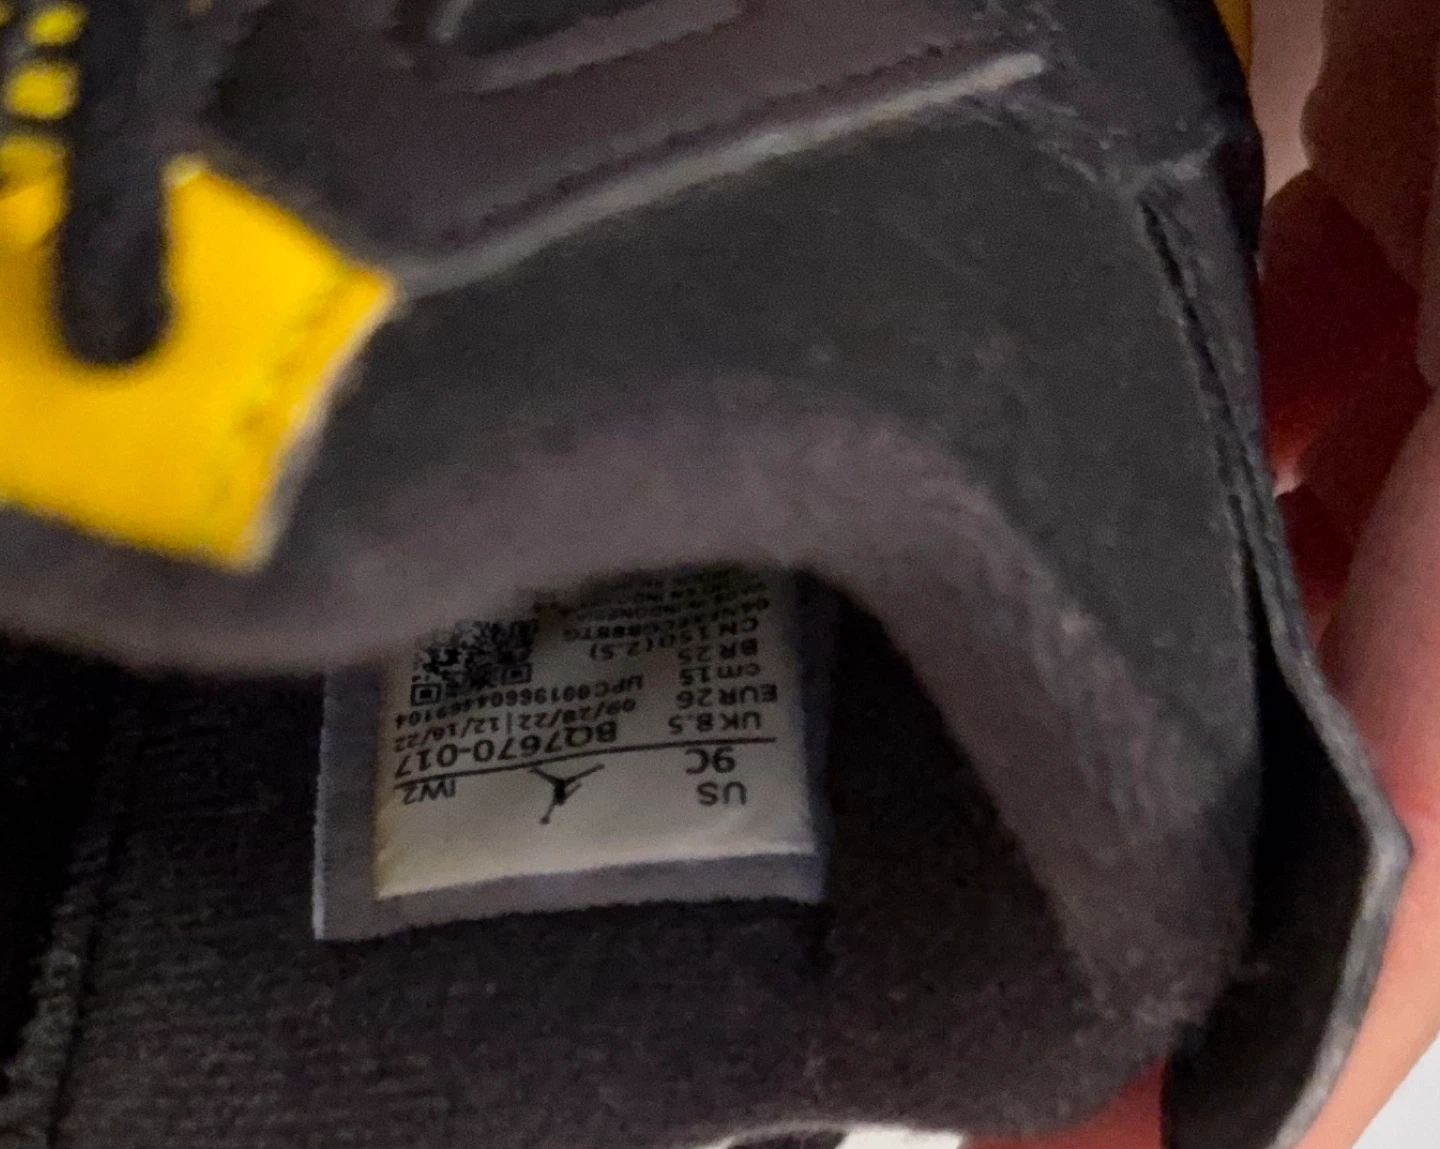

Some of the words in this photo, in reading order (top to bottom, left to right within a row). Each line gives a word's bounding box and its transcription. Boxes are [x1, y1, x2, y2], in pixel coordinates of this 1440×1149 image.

[393, 720, 618, 780] BQ7670-017
[683, 747, 737, 776] 9C
[696, 781, 748, 808] US
